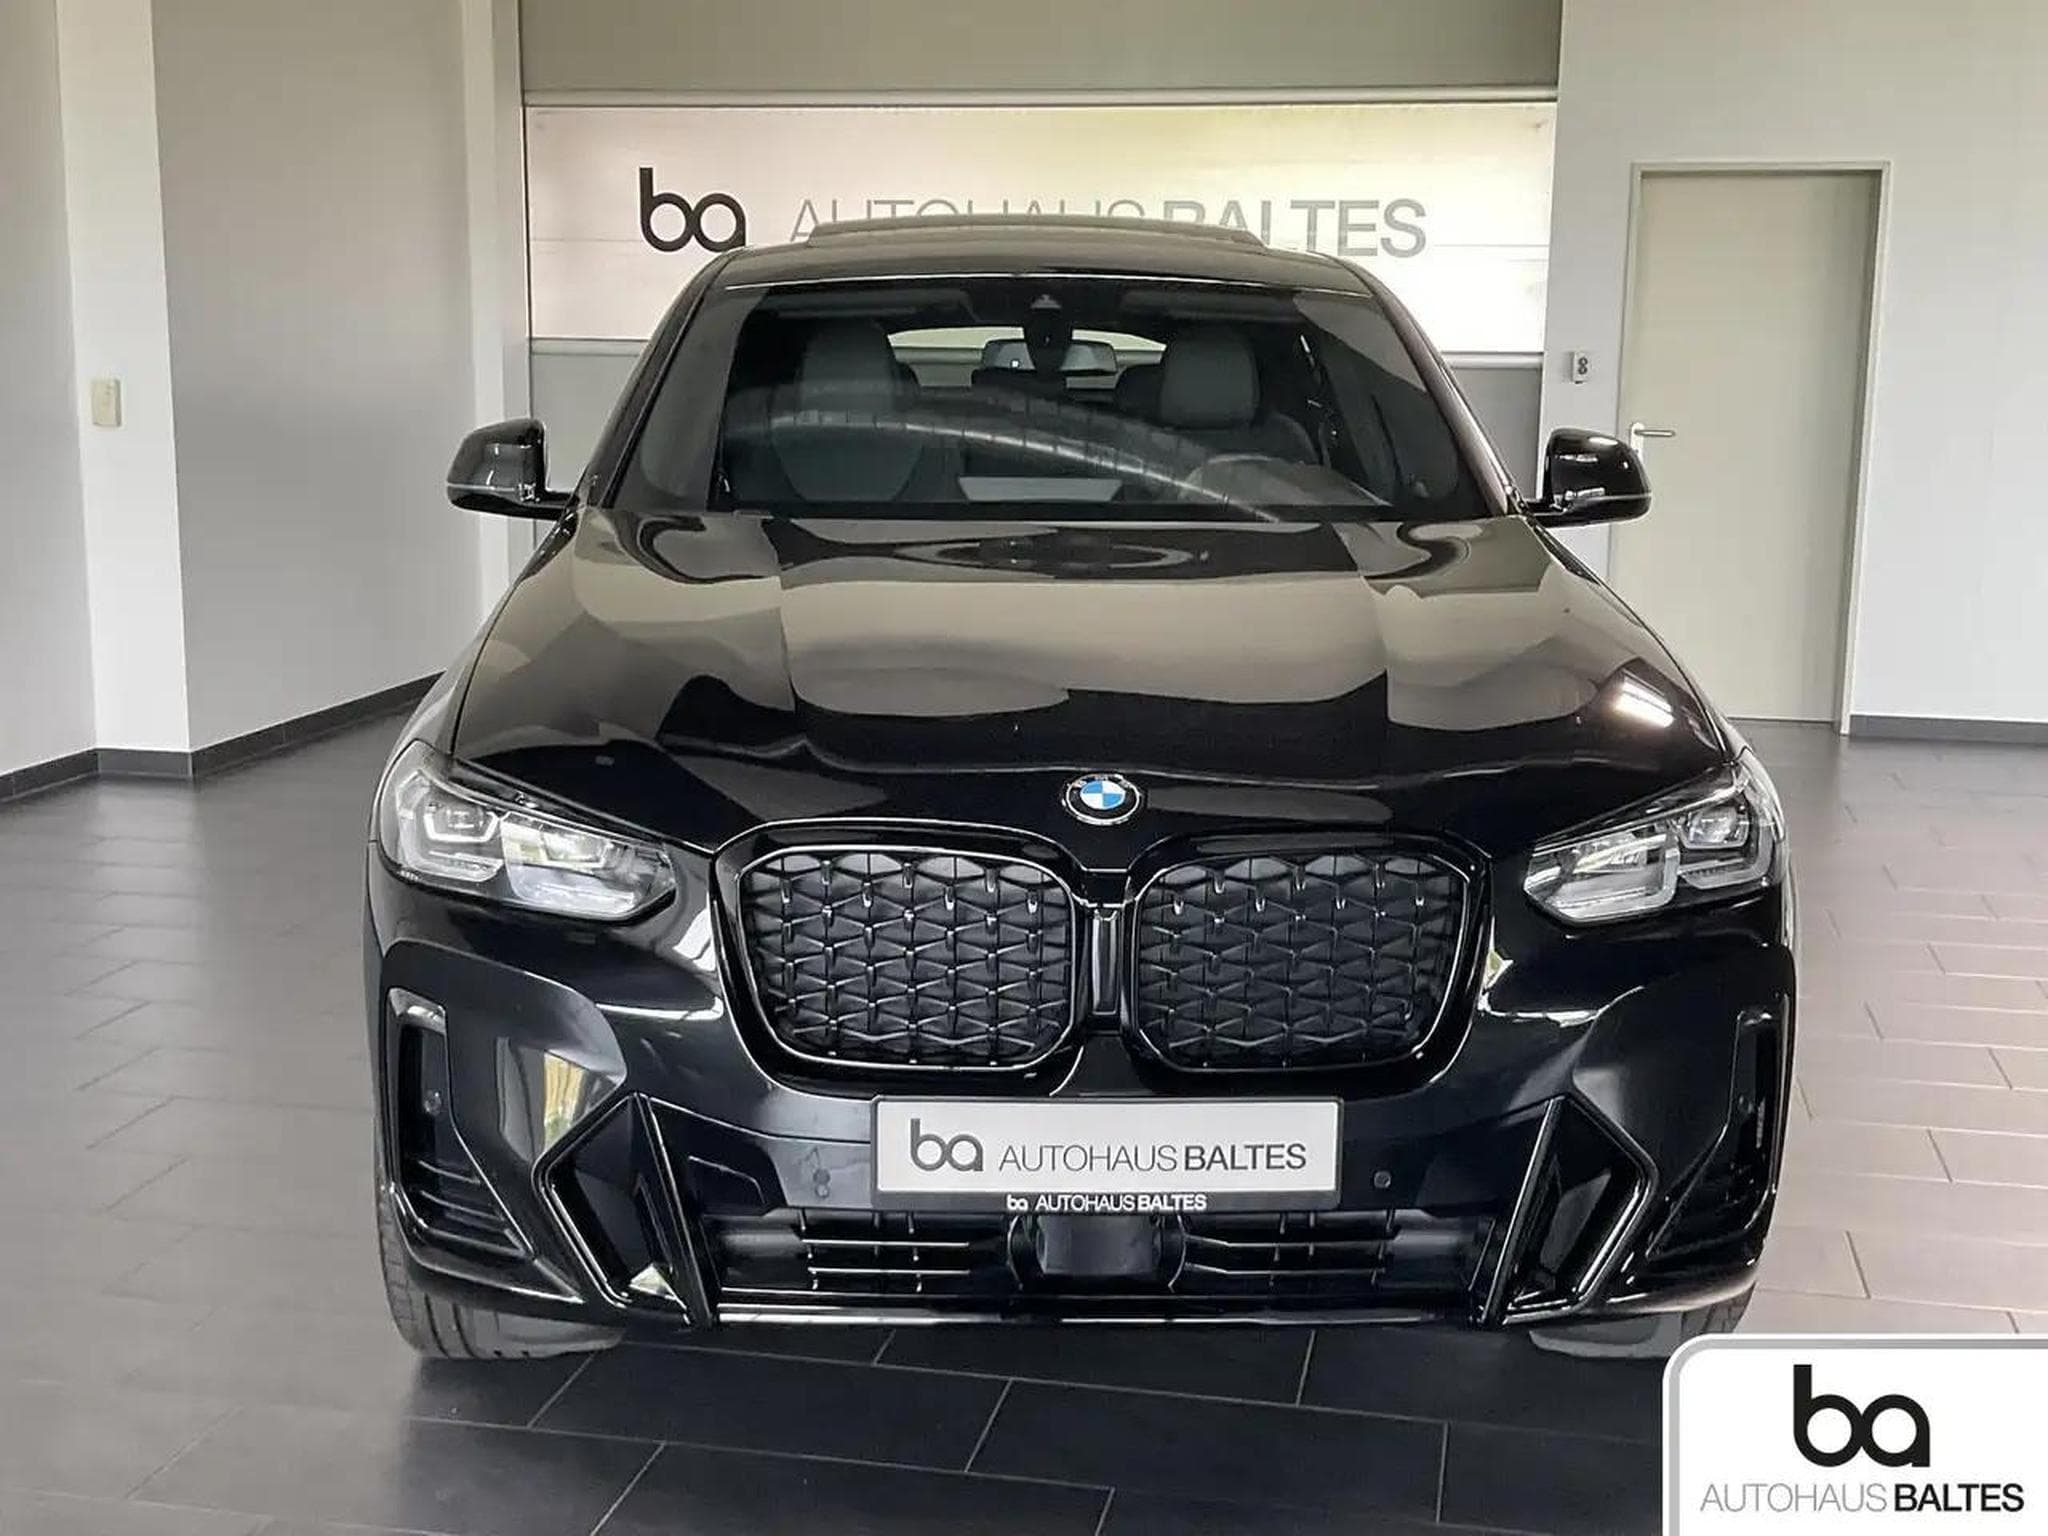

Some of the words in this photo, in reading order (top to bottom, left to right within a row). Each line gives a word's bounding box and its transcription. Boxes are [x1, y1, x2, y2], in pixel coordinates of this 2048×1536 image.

[639, 167, 746, 252] ba
[910, 1118, 984, 1172] ba
[998, 1144, 1178, 1172] AUTOHAUS
[1184, 1143, 1307, 1171] BALTES
[1006, 1194, 1029, 1211] ba
[1035, 1194, 1135, 1212] AUTOHAUS
[1137, 1194, 1207, 1212] BALTES
